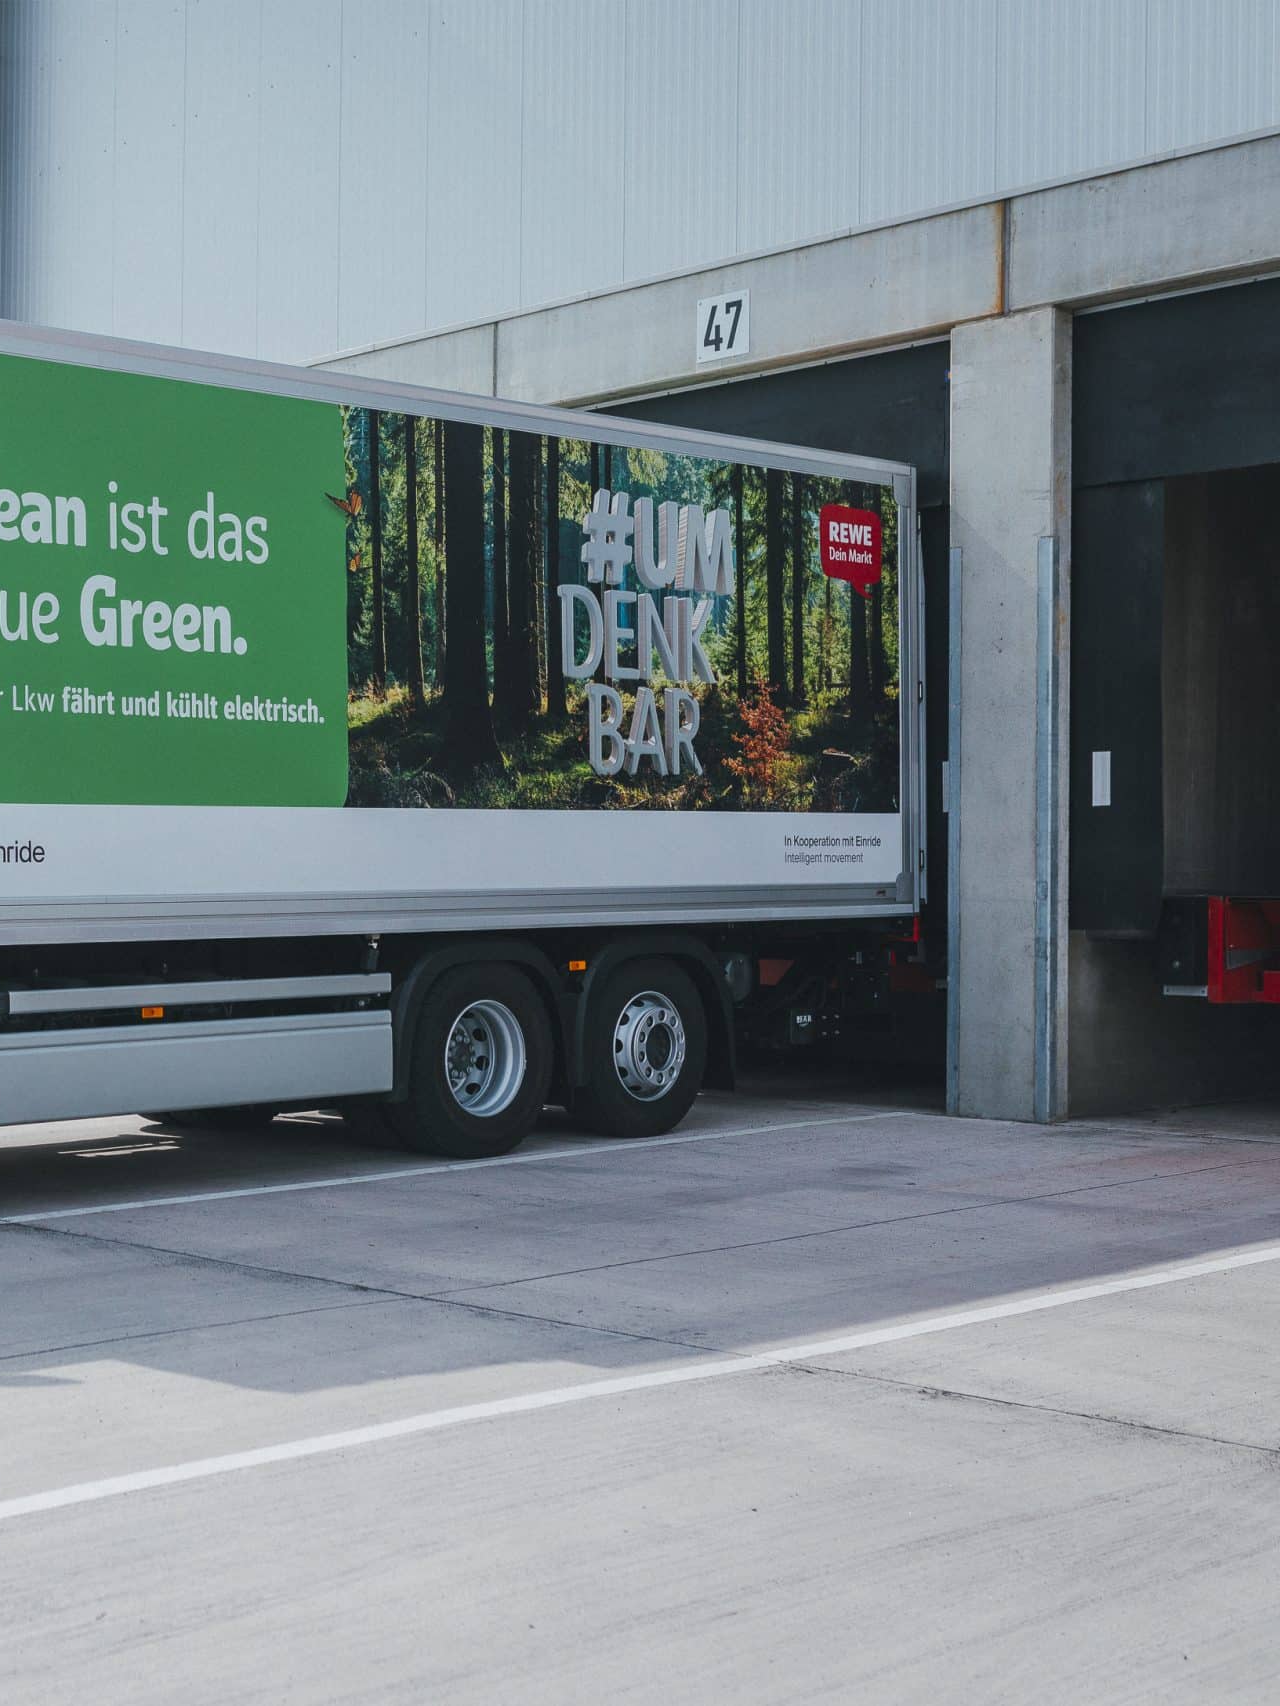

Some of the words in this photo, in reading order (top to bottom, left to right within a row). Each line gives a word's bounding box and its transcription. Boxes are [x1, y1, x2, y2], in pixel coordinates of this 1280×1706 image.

[703, 299, 742, 352] 47
[108, 480, 169, 556] ist
[187, 491, 269, 565] das
[581, 488, 735, 595] #UM
[828, 520, 873, 547] REWE
[828, 546, 847, 561] Dein
[848, 548, 873, 565] Markt
[79, 574, 248, 656] Green.
[557, 584, 717, 683] DENK
[12, 684, 55, 713] Lkw
[61, 686, 115, 715] fährt
[121, 690, 160, 717] und
[166, 691, 218, 720] kühlt
[223, 694, 325, 724] elektrisch.
[585, 683, 703, 776] BAR
[784, 835, 792, 847] In
[793, 835, 841, 848] Kooperation
[842, 835, 854, 847] mit
[855, 835, 881, 847] Einride
[784, 852, 822, 865] Intelligent
[823, 853, 864, 863] movement
